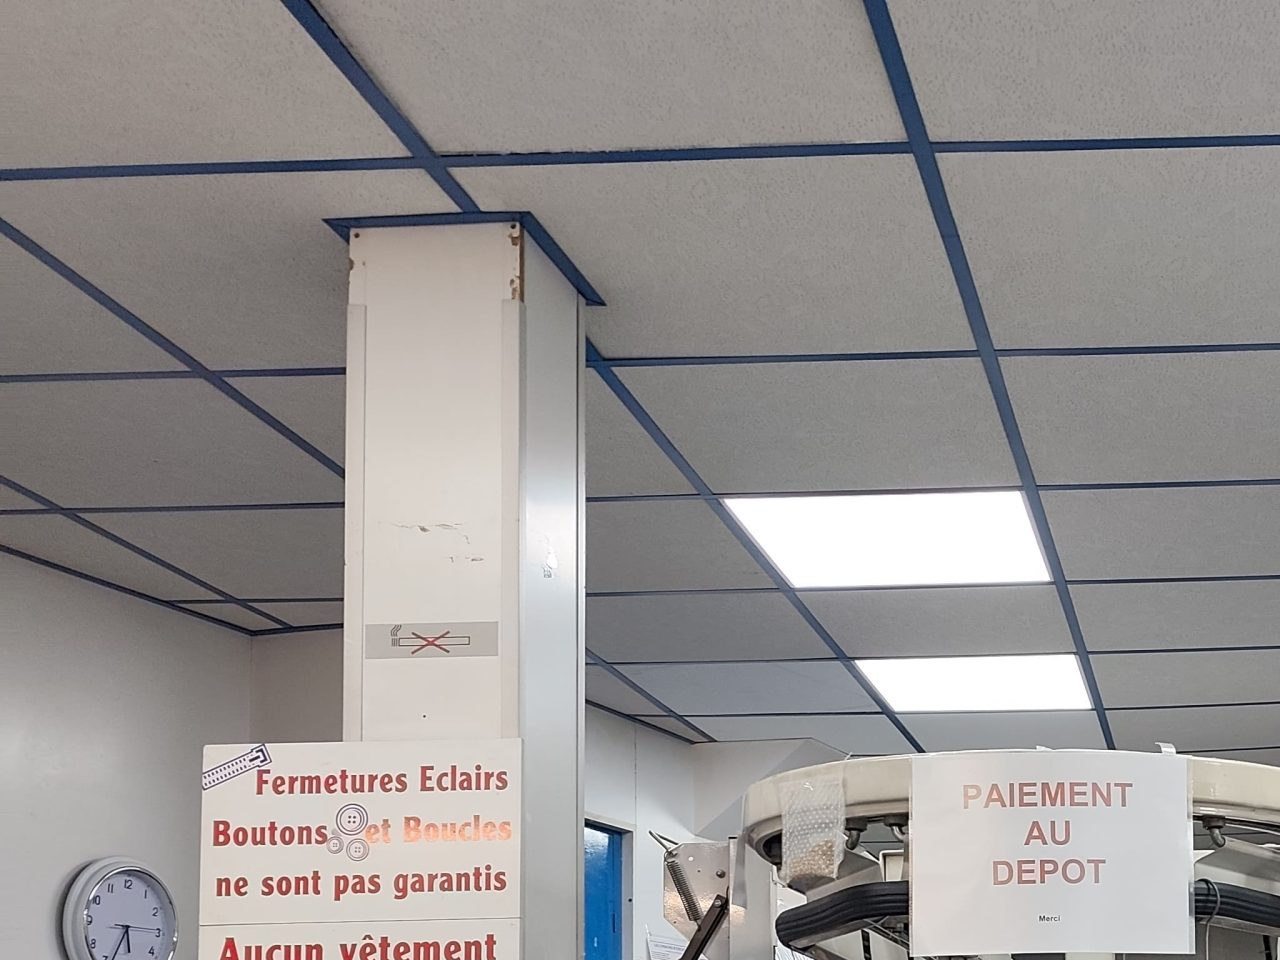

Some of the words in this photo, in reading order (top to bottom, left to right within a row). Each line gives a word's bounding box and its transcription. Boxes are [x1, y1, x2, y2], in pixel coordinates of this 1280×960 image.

[255, 769, 408, 795] Fermetures
[419, 764, 509, 792] Eclairs
[963, 782, 1133, 810] PAIEMENT
[212, 820, 328, 847] Boutons
[364, 818, 391, 844] et
[402, 814, 512, 843] Boucles
[1024, 820, 1071, 846] AU
[215, 873, 248, 897] ne
[260, 870, 321, 895] sont
[333, 873, 381, 901] pas
[393, 864, 507, 900] garantis
[992, 859, 1106, 886] DEPOT
[1039, 915, 1061, 923] Merci
